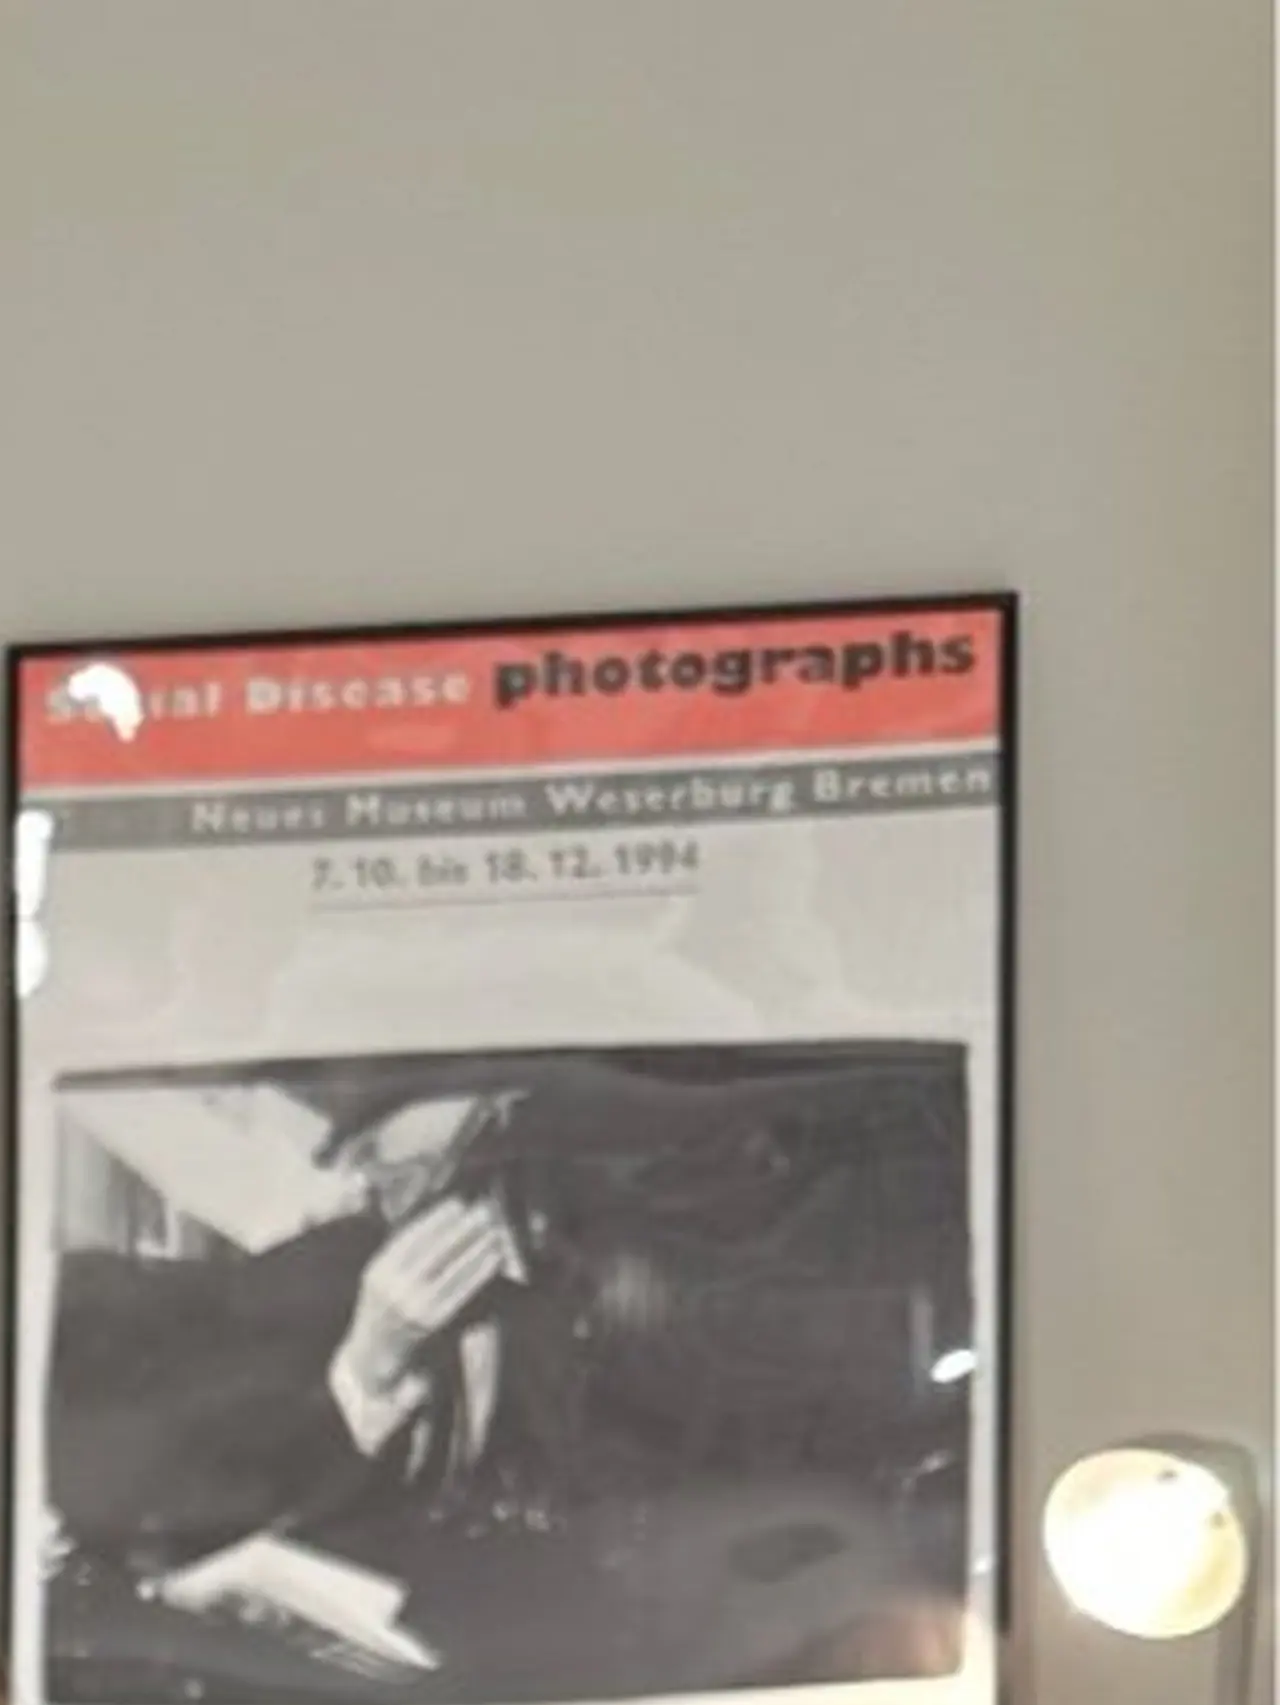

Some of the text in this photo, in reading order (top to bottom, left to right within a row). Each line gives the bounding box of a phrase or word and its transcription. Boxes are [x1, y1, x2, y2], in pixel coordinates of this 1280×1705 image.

[246, 674, 471, 716] Disease
[494, 630, 977, 708] photographs
[190, 764, 992, 833] Neues Museum Weserburg Bremen
